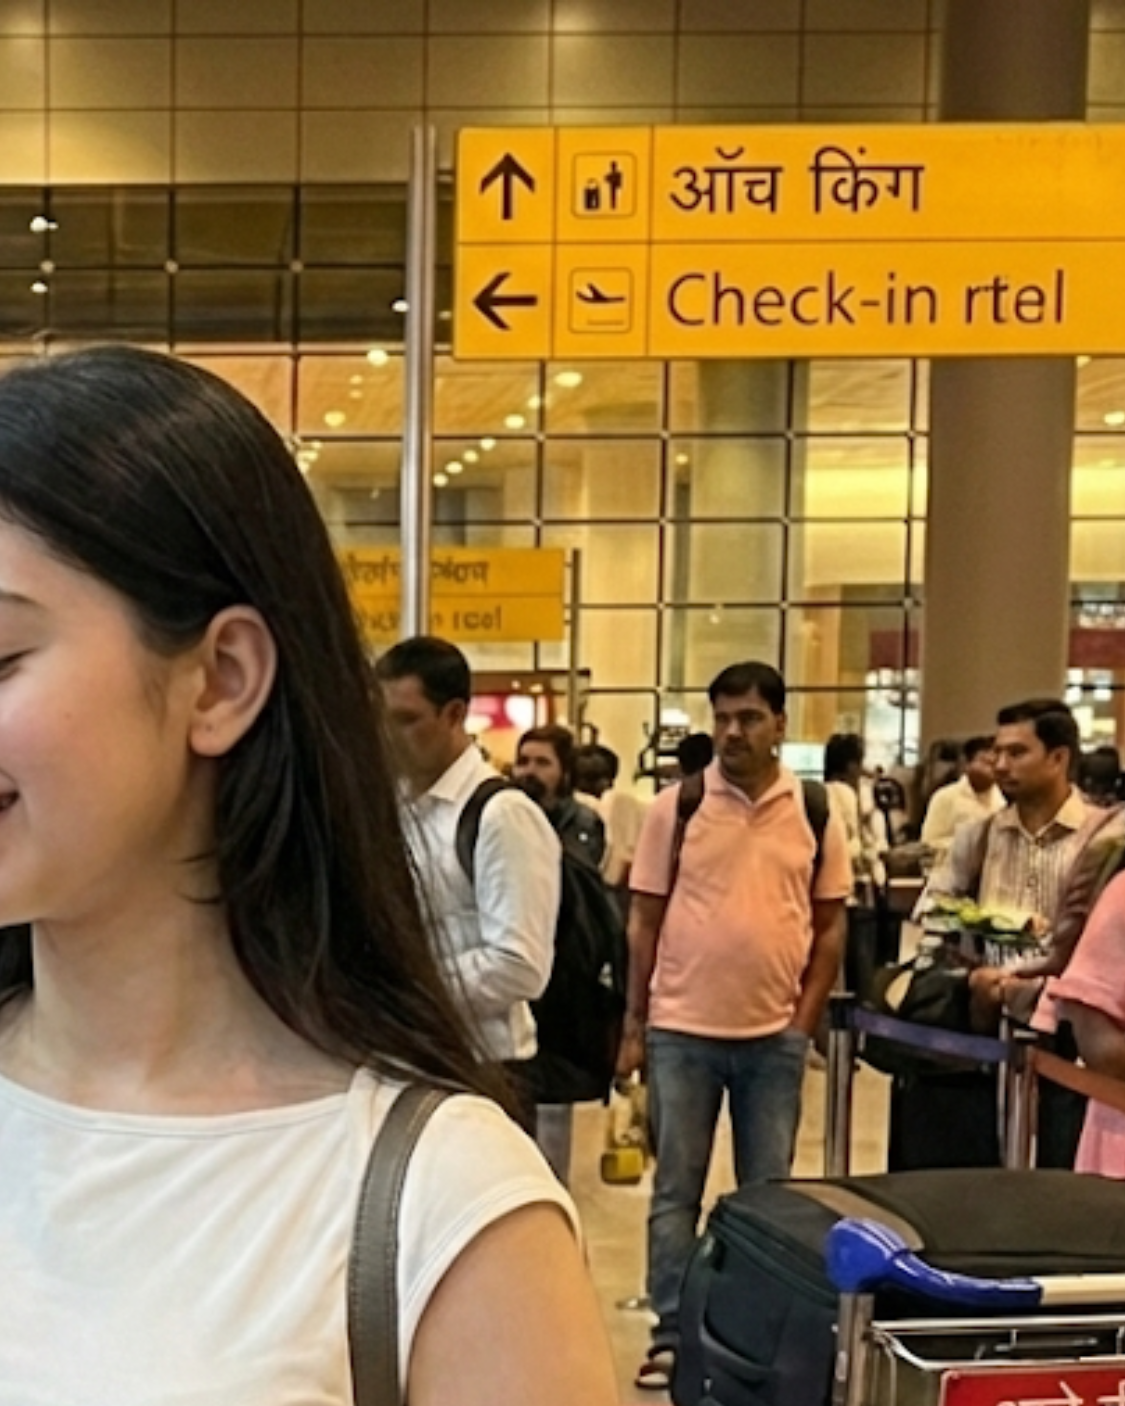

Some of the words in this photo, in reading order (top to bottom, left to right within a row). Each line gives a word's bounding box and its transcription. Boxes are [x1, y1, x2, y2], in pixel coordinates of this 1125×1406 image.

[807, 145, 925, 214] किंग
[667, 269, 937, 326] Check-in
[964, 268, 1065, 325] rtel
